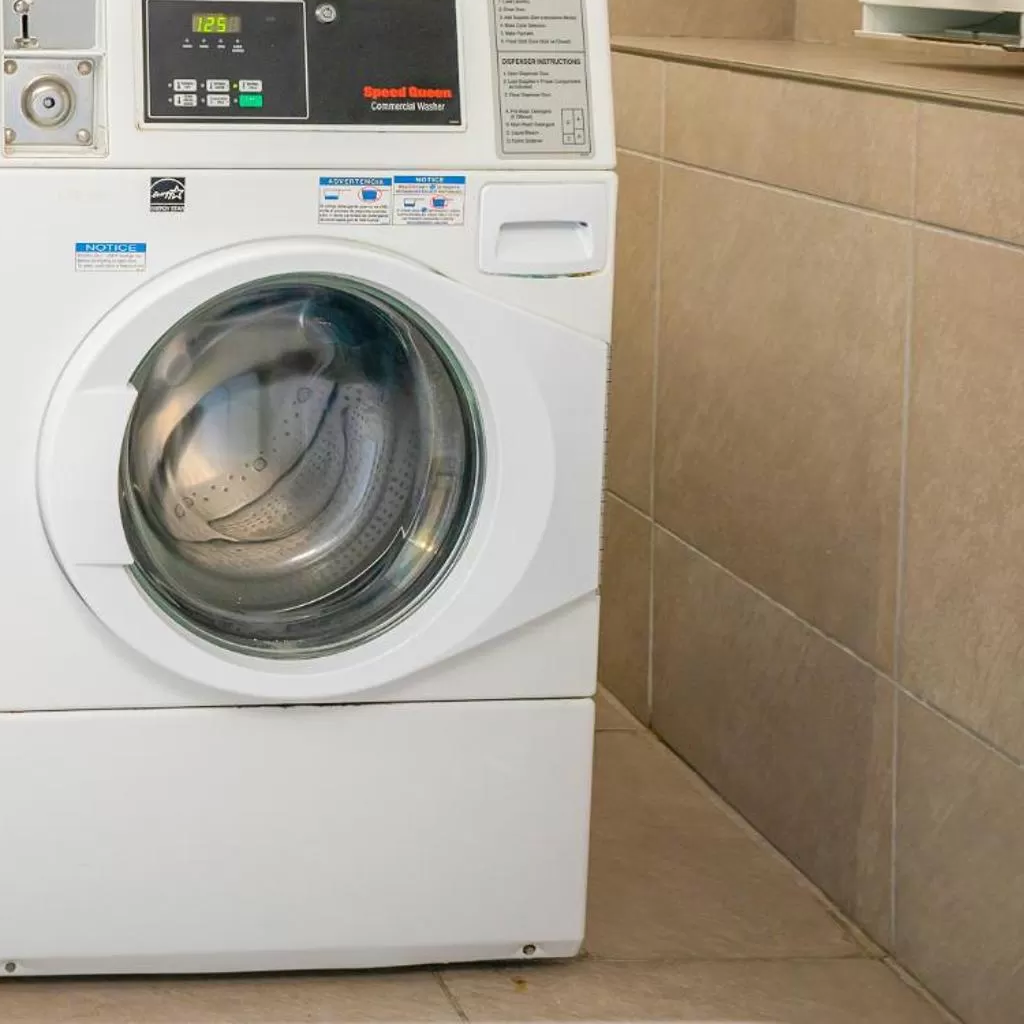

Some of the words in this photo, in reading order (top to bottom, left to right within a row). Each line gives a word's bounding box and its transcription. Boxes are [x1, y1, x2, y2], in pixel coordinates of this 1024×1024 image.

[197, 16, 227, 32] 125
[363, 86, 407, 99] Speed
[408, 86, 453, 98] Queen
[370, 101, 416, 112] Commercial
[417, 102, 446, 112] Washer
[415, 176, 444, 184] NOTICE
[85, 243, 137, 252] NOTICE
